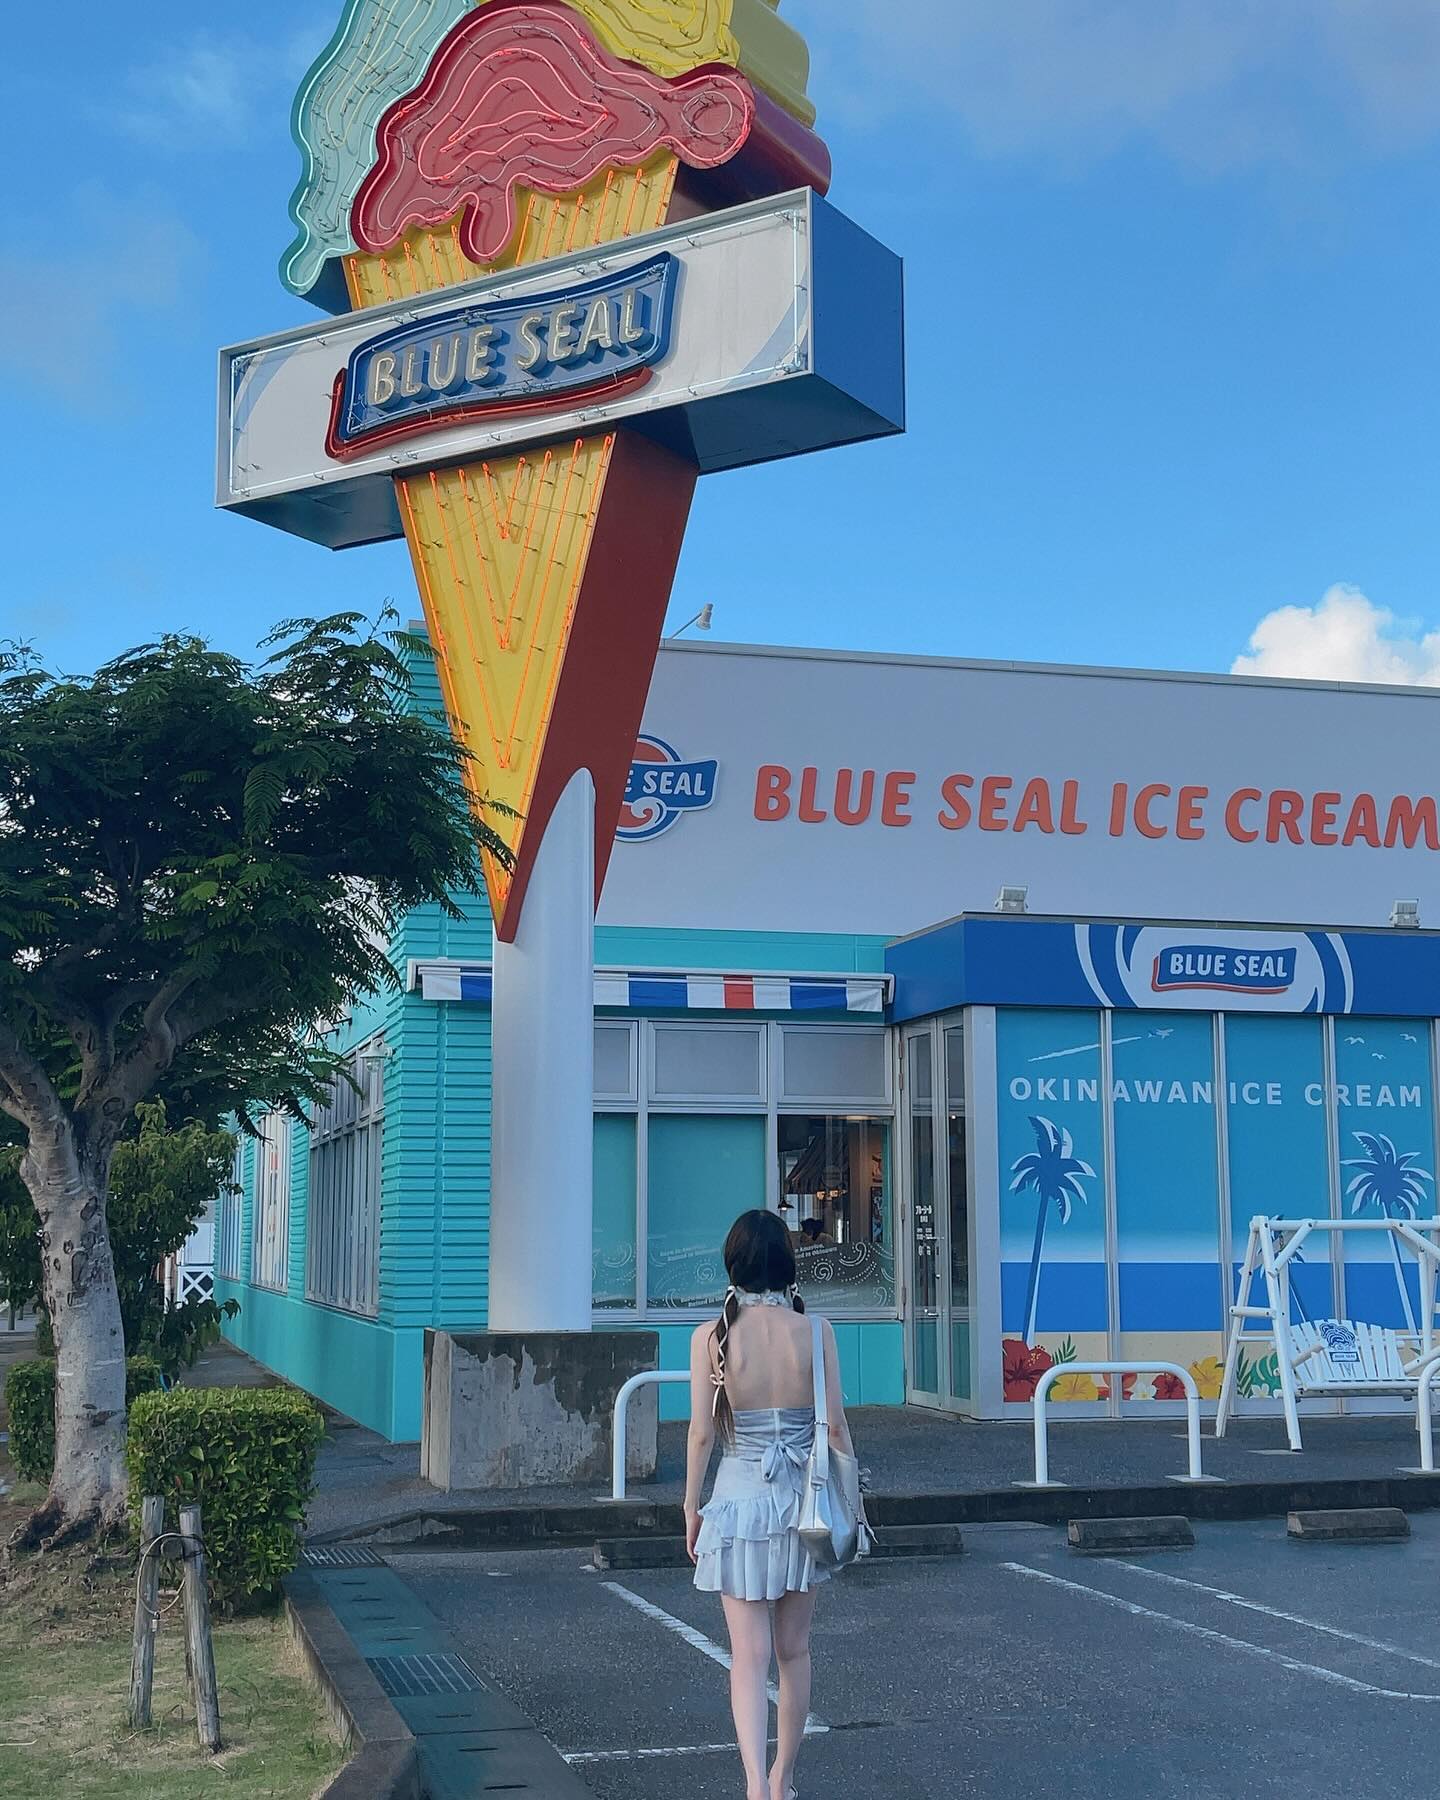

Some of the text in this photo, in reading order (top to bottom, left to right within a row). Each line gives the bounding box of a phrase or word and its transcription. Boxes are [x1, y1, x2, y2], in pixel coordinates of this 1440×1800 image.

[367, 286, 647, 406] BLUE SEAL
[642, 770, 706, 796] SEAL
[754, 764, 1440, 850] BLUE SEAL ICE CREAM
[1169, 953, 1288, 978] BLUE SEAL
[1229, 1082, 1282, 1105] ICE
[1304, 1083, 1422, 1108] CREAM
